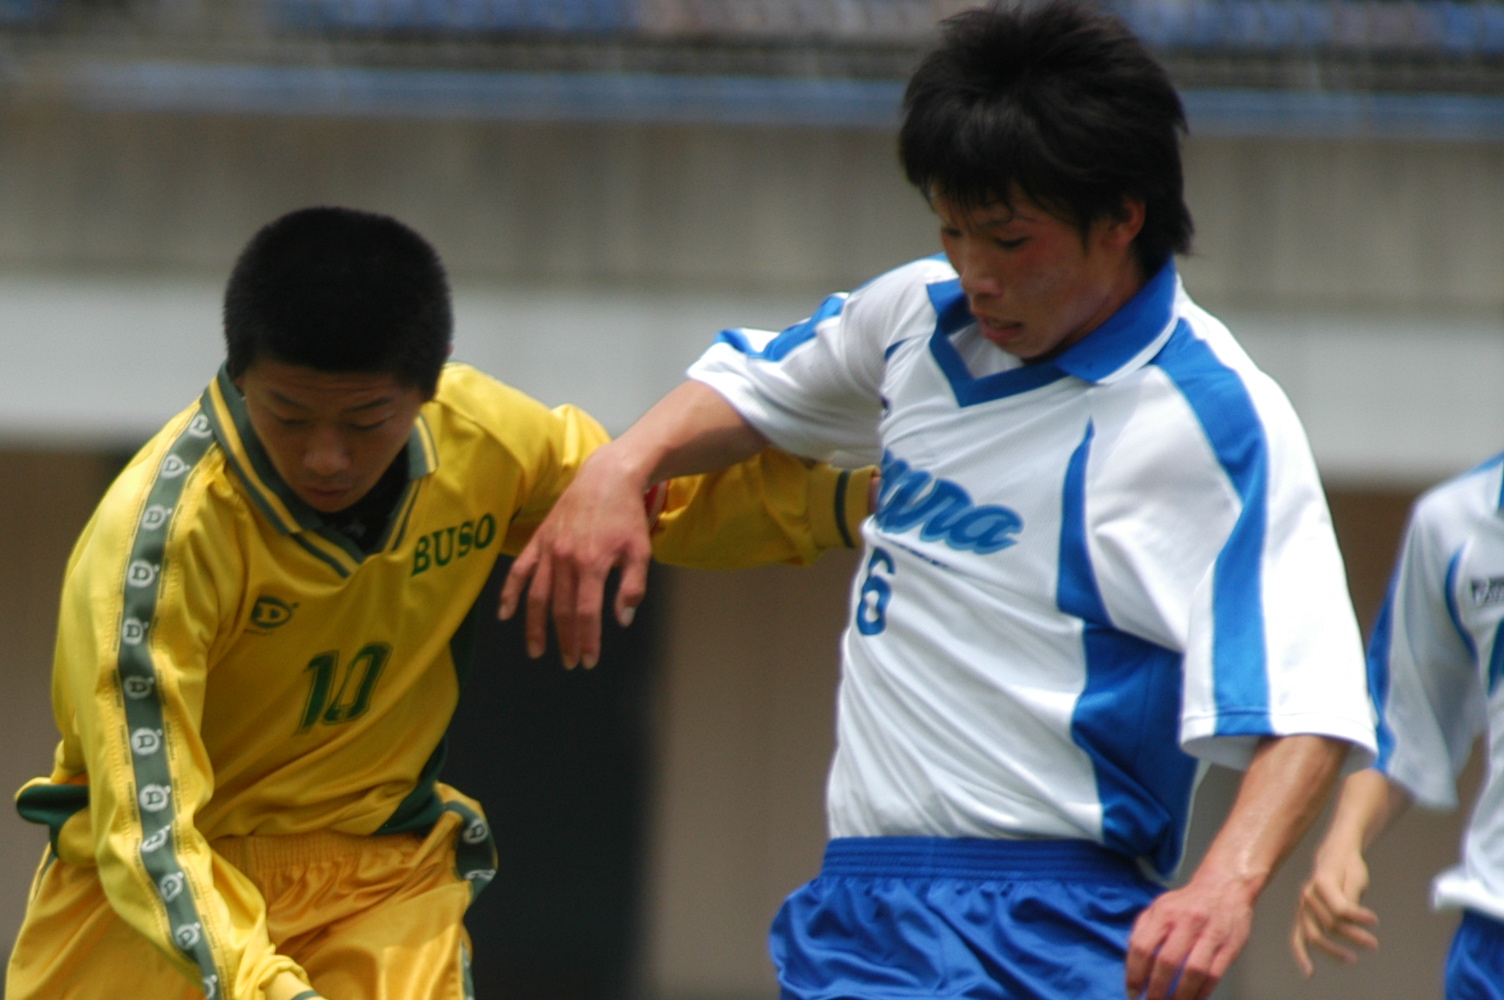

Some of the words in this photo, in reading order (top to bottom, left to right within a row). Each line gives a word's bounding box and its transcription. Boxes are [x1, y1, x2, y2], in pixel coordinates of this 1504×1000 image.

[411, 513, 497, 578] BUSO
[857, 546, 895, 636] 6
[296, 643, 392, 734] 10
